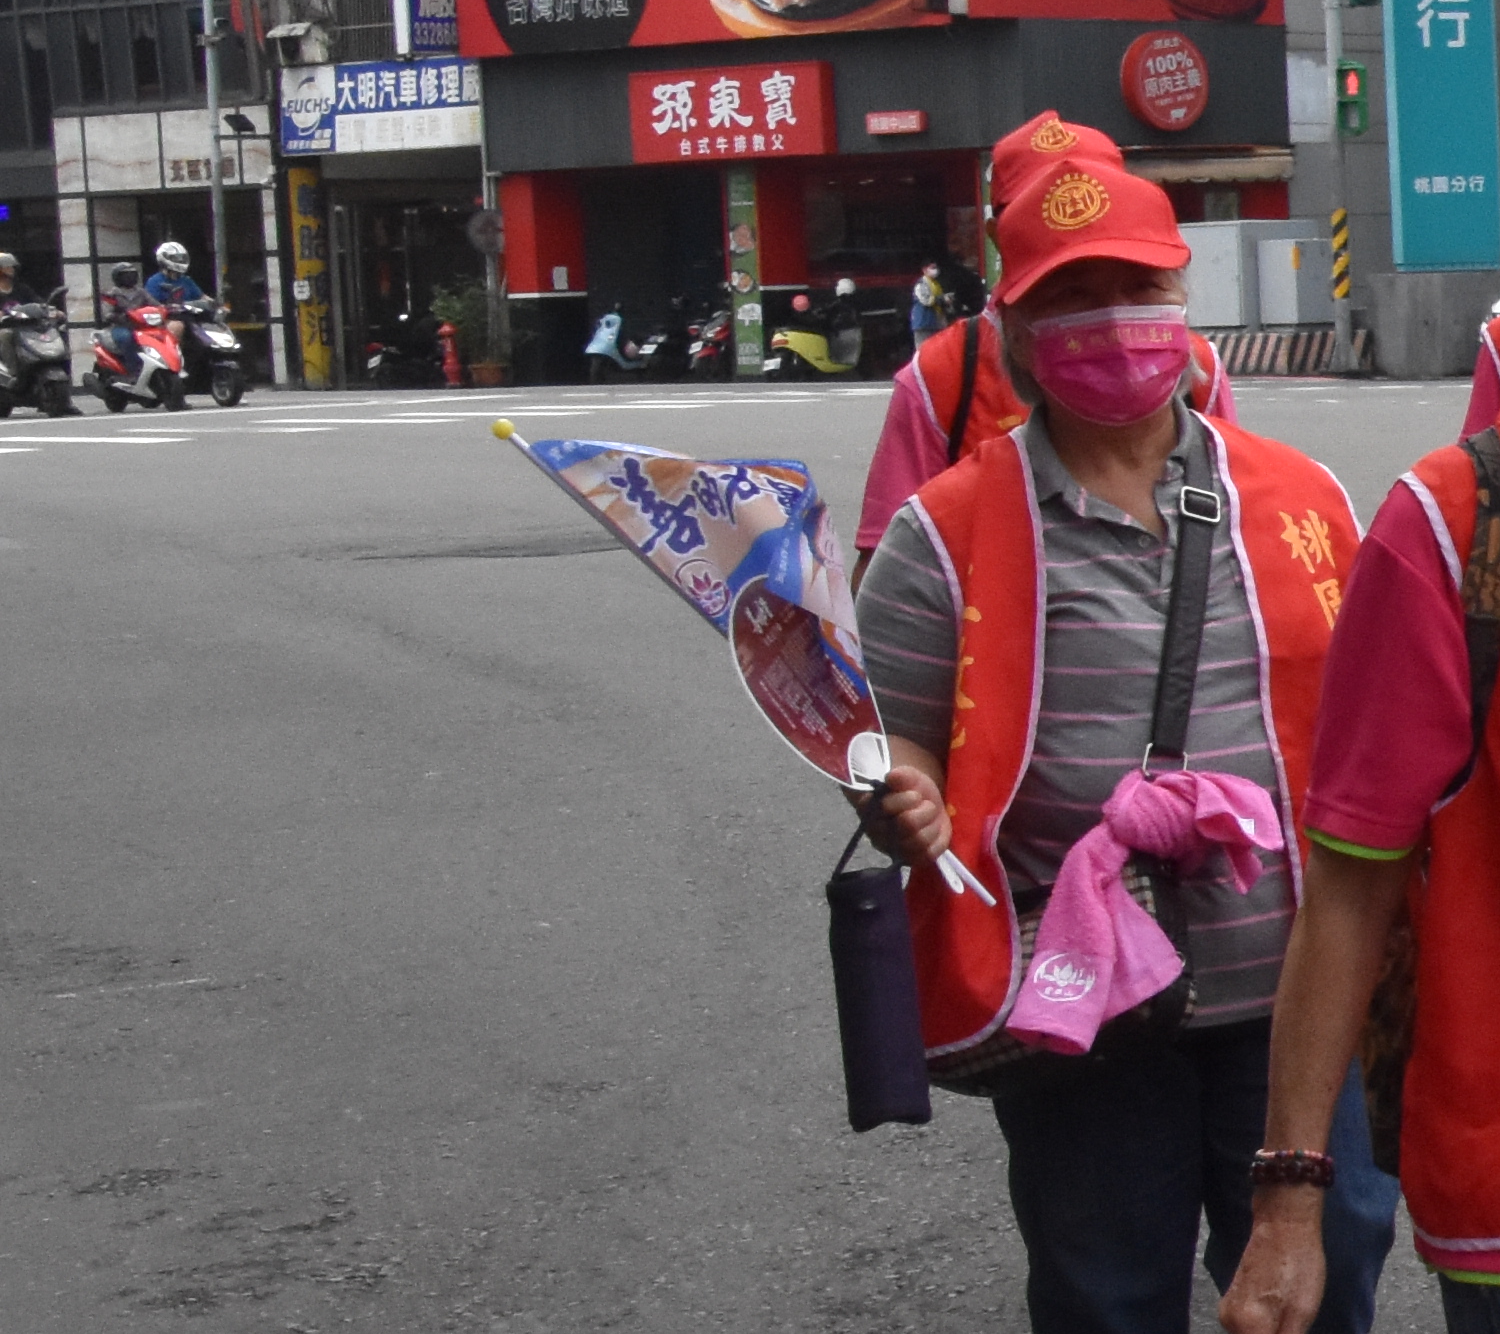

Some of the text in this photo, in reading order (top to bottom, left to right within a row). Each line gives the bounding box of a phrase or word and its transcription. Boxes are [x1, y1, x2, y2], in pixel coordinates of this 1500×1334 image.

[1145, 50, 1194, 76] 100%
[286, 97, 330, 115] FUCHS
[651, 70, 798, 135] 孫東寶
[679, 133, 785, 156] 台式牛排教父
[1414, 176, 1486, 194] 桃園分行
